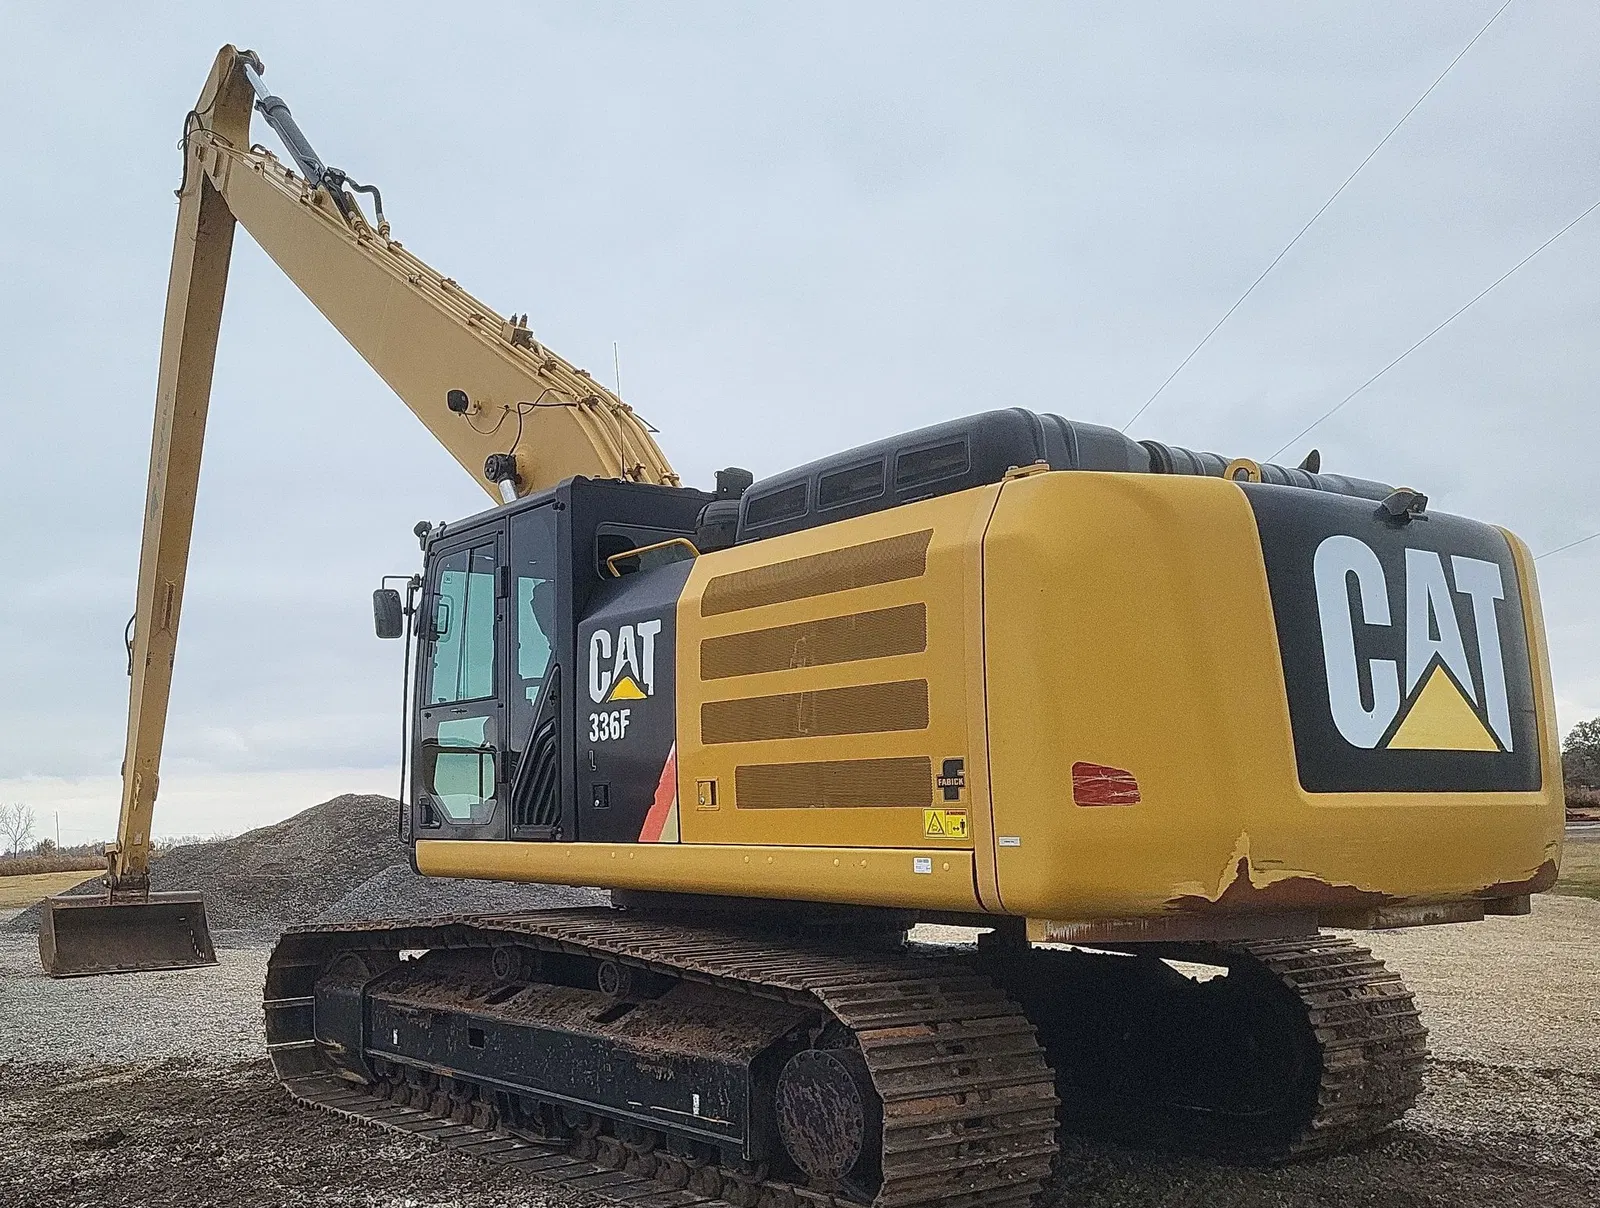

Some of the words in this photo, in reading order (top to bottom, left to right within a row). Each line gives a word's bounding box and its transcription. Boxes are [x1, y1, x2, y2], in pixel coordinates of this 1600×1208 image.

[589, 619, 662, 704] CAT
[1313, 534, 1513, 752] CAT
[589, 708, 631, 742] 336F
[938, 778, 964, 786] FABICK
